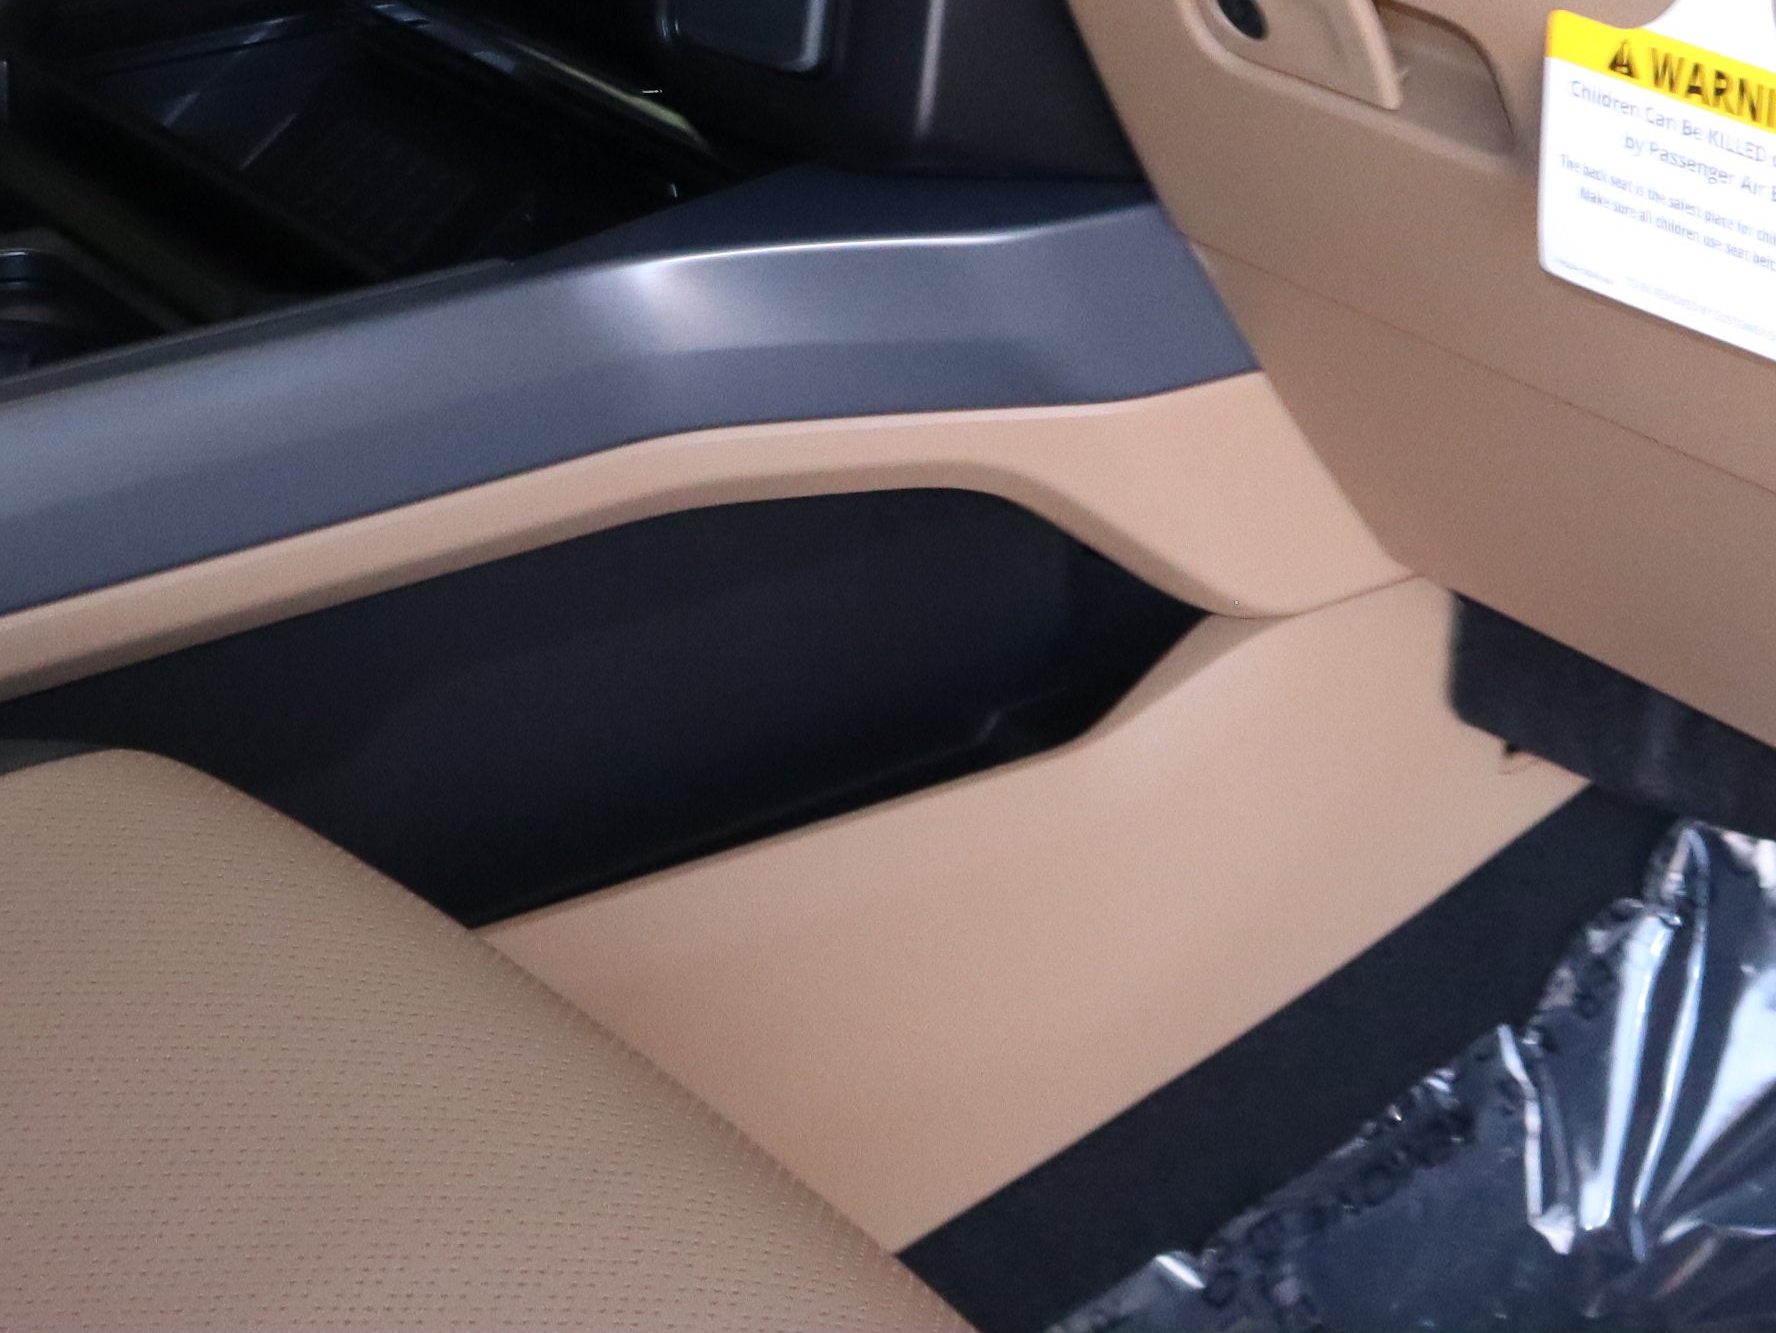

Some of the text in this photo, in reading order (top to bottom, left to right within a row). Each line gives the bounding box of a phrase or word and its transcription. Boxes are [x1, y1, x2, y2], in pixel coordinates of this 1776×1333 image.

[1570, 79, 1638, 116] Children
[1646, 106, 1675, 131] Can
[1682, 117, 1703, 141] Be
[1708, 127, 1766, 163] KILLED
[1557, 151, 1581, 174] The
[1582, 161, 1607, 183] back
[1609, 174, 1632, 194] seat
[1634, 182, 1645, 198] is
[1647, 184, 1667, 205] the
[1668, 193, 1701, 217] safest
[1704, 208, 1733, 231] place
[1736, 219, 1754, 238] for
[1624, 132, 1643, 157] by
[1650, 140, 1735, 185] Passenger
[1741, 174, 1766, 197] Air
[1578, 183, 1609, 209] Make
[1612, 198, 1638, 220] sure
[1639, 208, 1652, 226] all
[1655, 214, 1700, 242] children
[1703, 233, 1723, 252] use
[1725, 241, 1750, 262] seat
